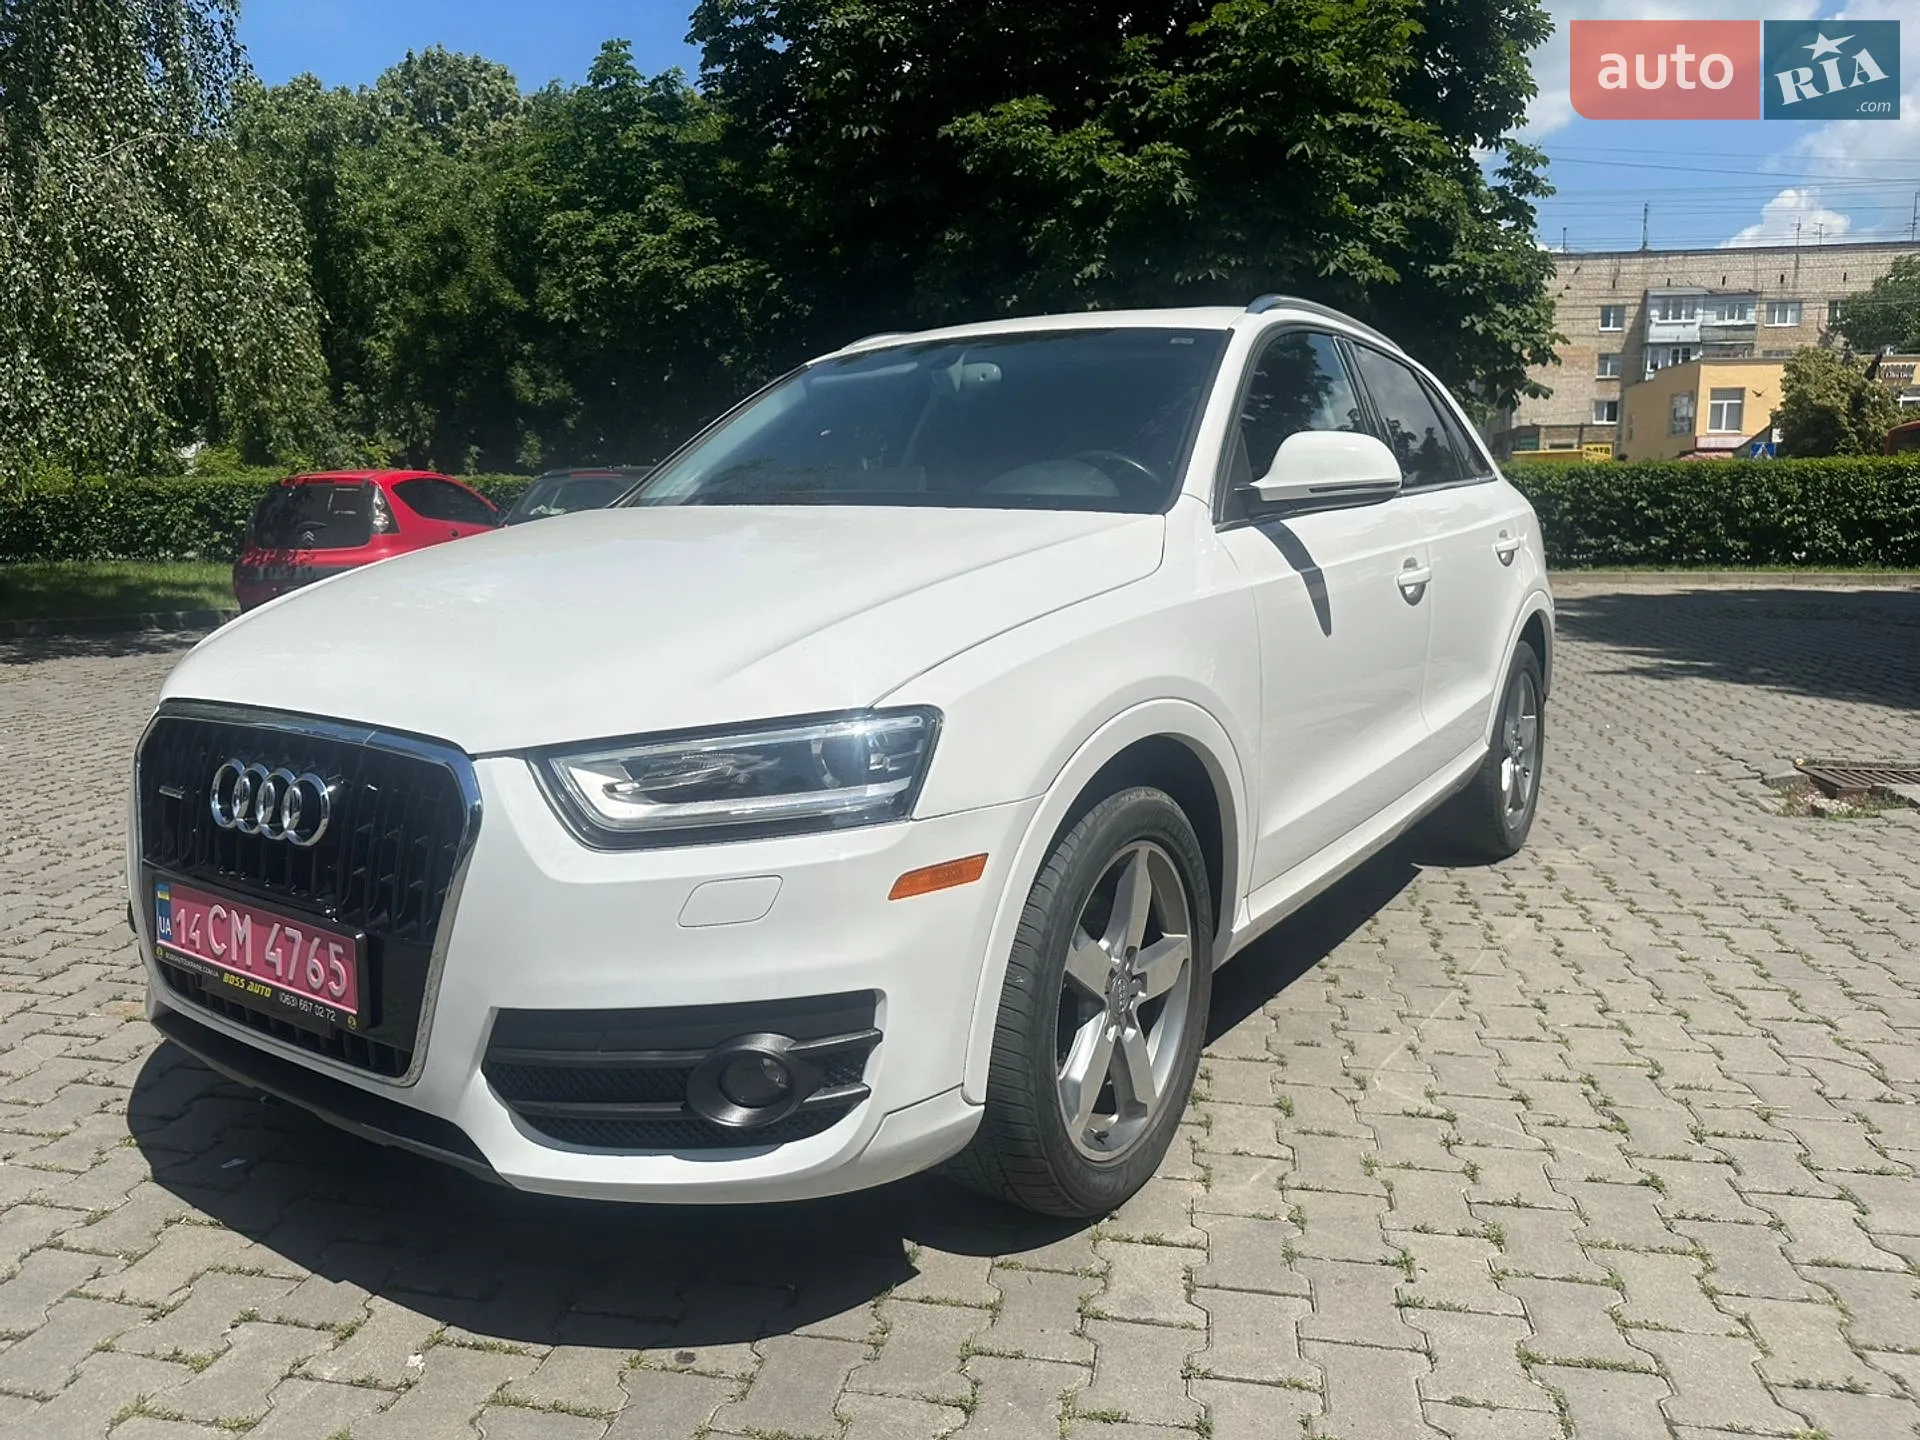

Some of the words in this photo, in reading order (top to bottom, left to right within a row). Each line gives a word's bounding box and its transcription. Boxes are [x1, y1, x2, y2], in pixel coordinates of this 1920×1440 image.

[158, 915, 172, 936] UA
[264, 923, 347, 997] 4765
[223, 972, 246, 989] BOSS
